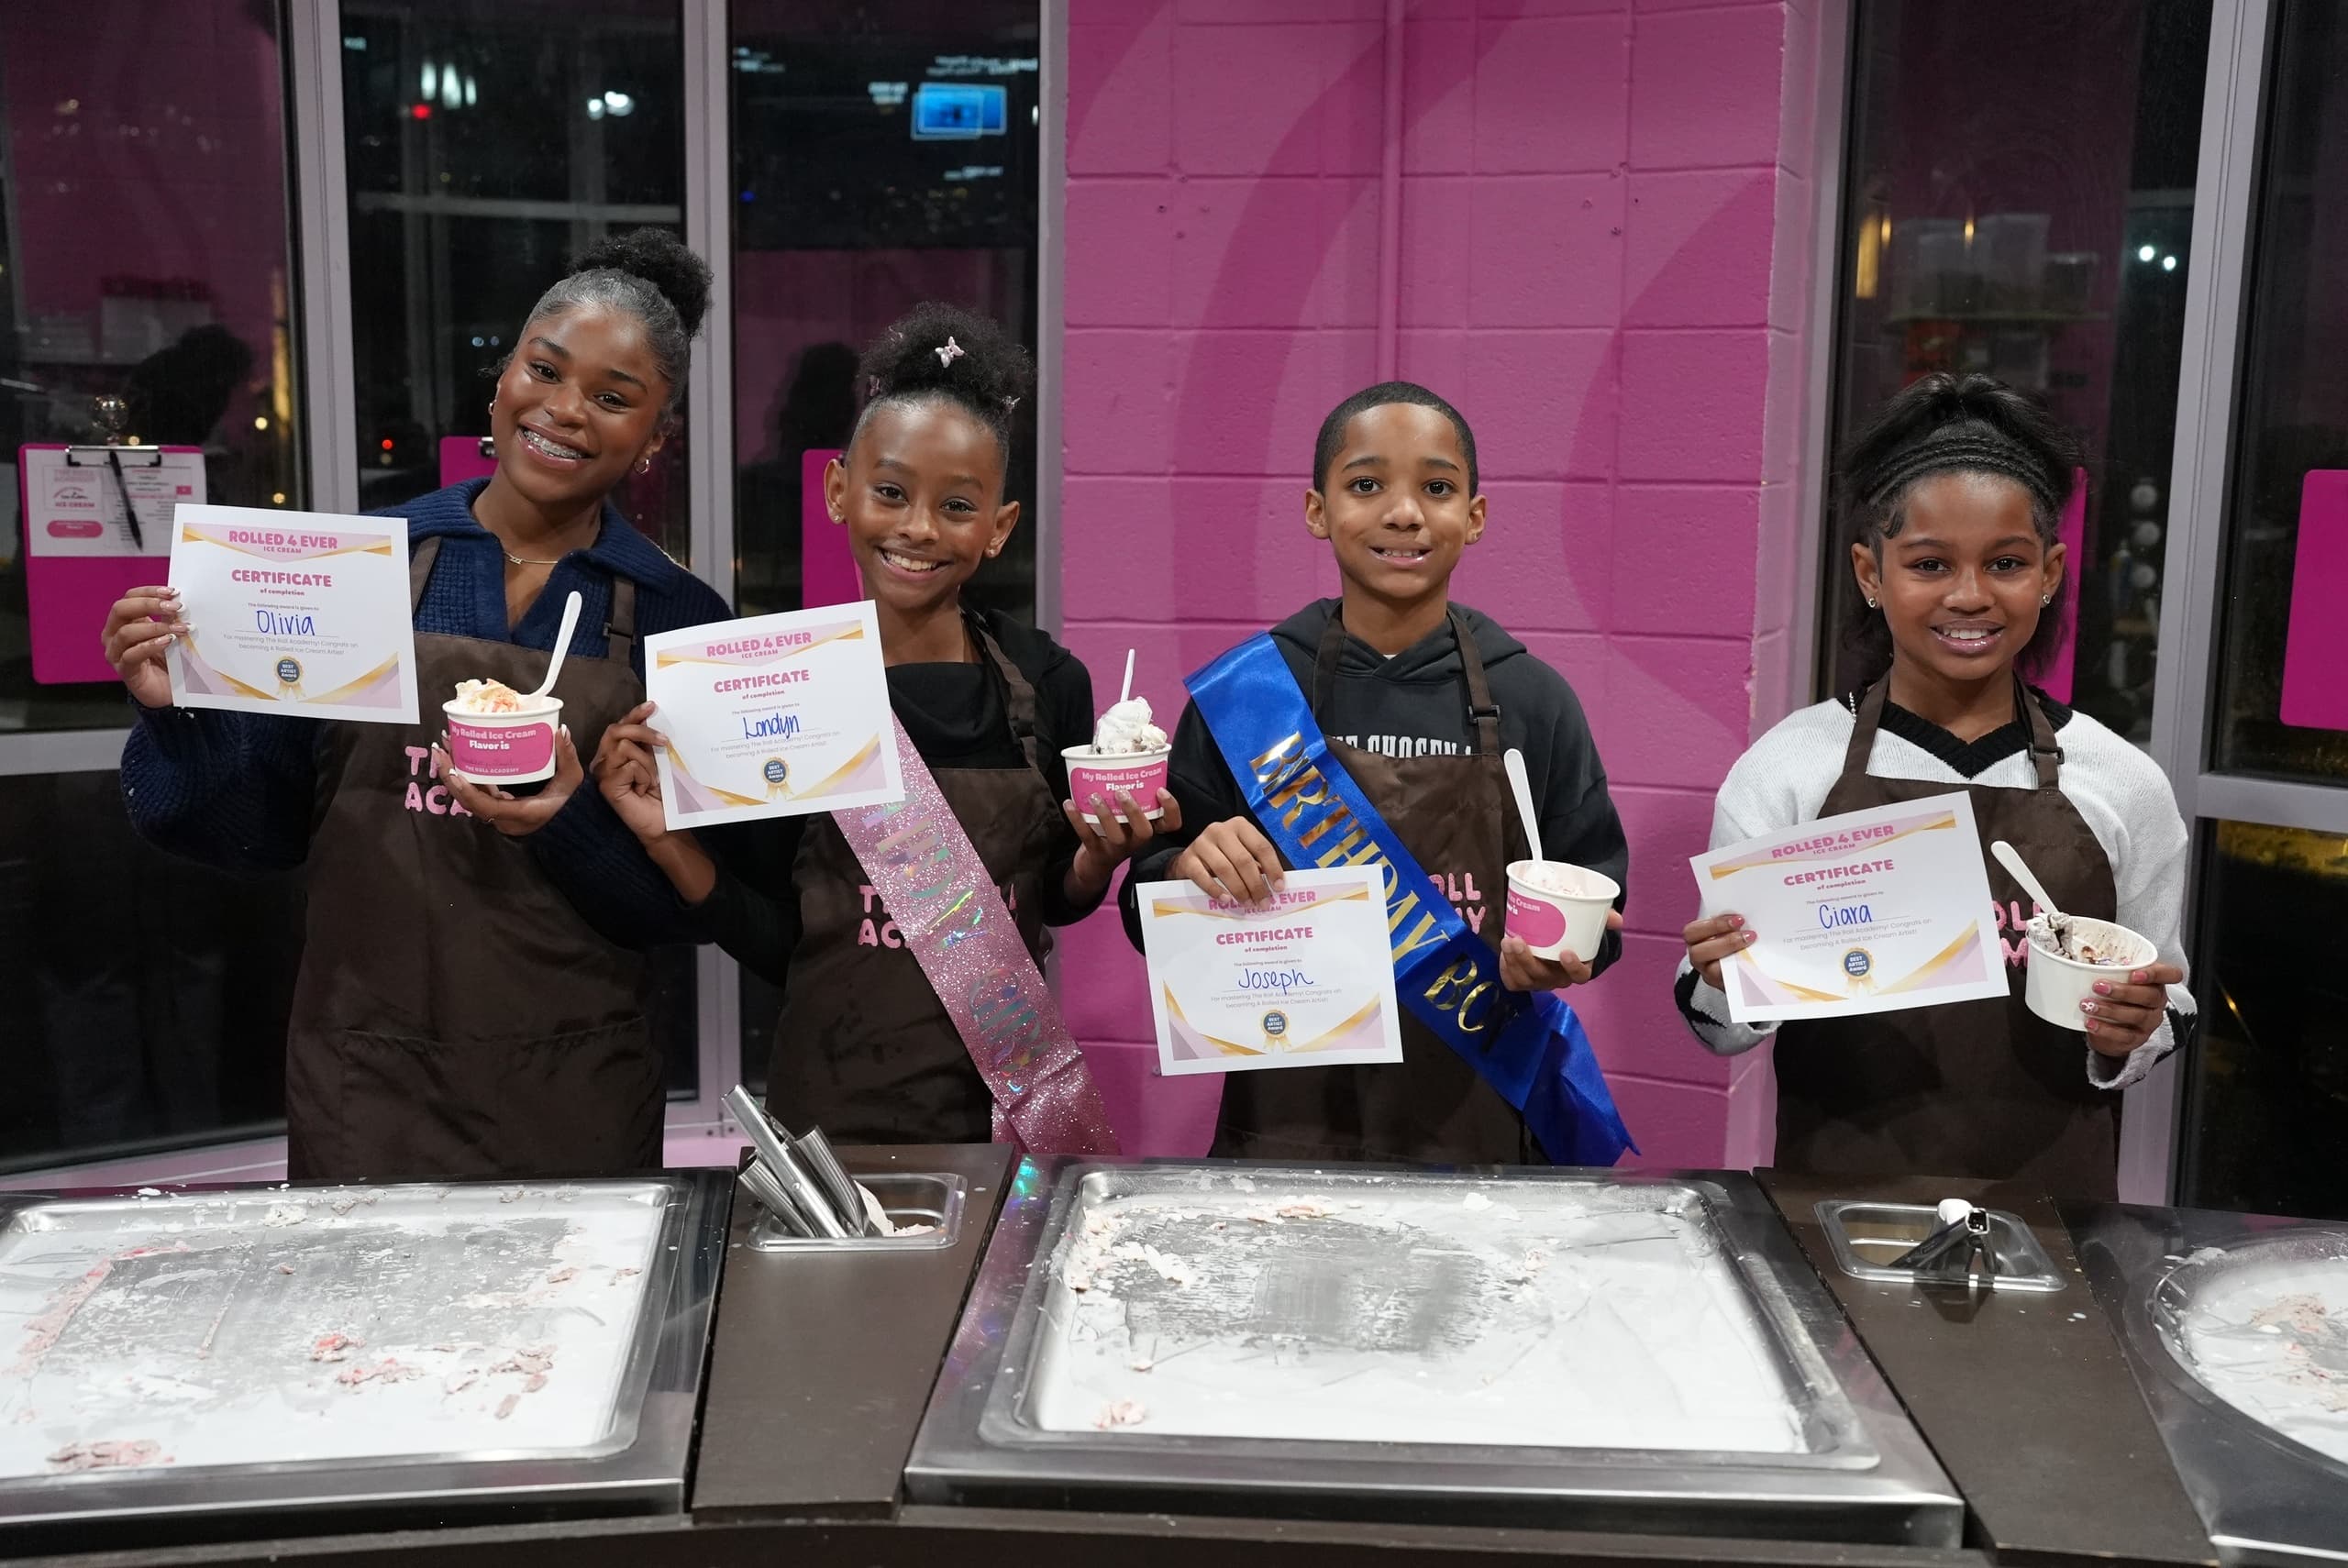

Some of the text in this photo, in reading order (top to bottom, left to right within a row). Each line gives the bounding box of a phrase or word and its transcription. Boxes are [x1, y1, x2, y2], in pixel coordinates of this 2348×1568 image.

[229, 530, 338, 550] ROLLED 4 EVER
[231, 569, 332, 587] CERTIFICATE
[257, 610, 315, 635] Olivia
[706, 632, 812, 657] ROLLED 4 EVER
[755, 649, 778, 657] CREAM
[714, 669, 810, 693] CERTIFICATE
[750, 690, 784, 699] completion
[460, 728, 488, 739] Rolled
[505, 730, 536, 739] Cream
[743, 712, 800, 739] Londyn
[470, 740, 510, 749] Flavor is
[1082, 772, 1093, 782] My
[1095, 773, 1124, 781] Rolled
[1140, 767, 1162, 778] Cream
[1106, 780, 1144, 791] Flavor is
[1250, 732, 1451, 963] BIRTHDAY
[1772, 825, 1894, 858] ROLLED 4 EVER
[1829, 844, 1855, 852] CREAM
[1784, 859, 1895, 886] CERTIFICATE
[1826, 879, 1866, 889] completion
[1279, 891, 1316, 904] EVER
[1516, 898, 1541, 911] Cream
[1820, 904, 1872, 929] Ciara
[1216, 927, 1313, 944] CERTIFICATE
[1238, 968, 1313, 995] Joseph
